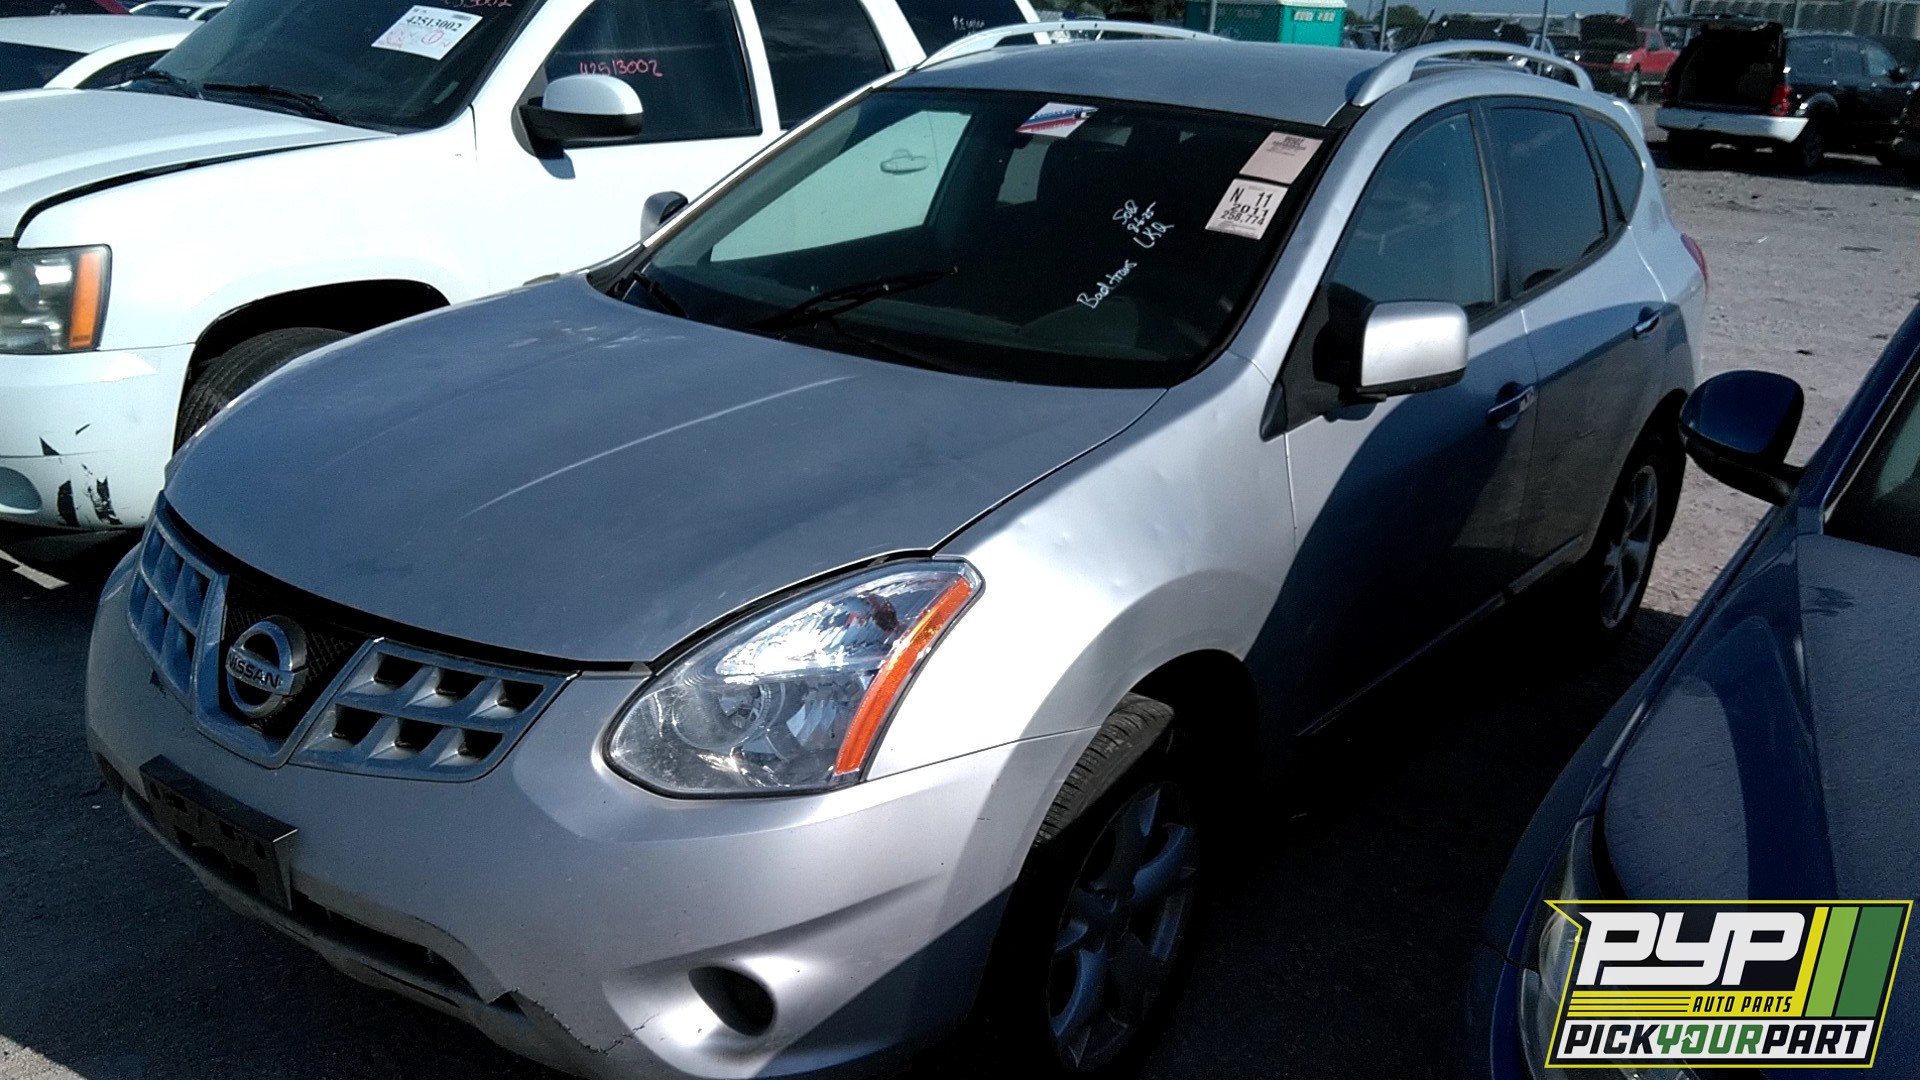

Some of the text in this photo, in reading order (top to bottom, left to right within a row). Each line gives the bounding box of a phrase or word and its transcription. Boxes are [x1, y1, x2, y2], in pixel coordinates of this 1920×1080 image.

[406, 15, 463, 32] 42513002
[580, 59, 663, 77] 42513002
[1229, 187, 1244, 204] N
[1255, 191, 1274, 208] 11
[1230, 203, 1269, 217] 2011
[1076, 281, 1112, 309] Bad
[228, 652, 280, 689] NISSAN
